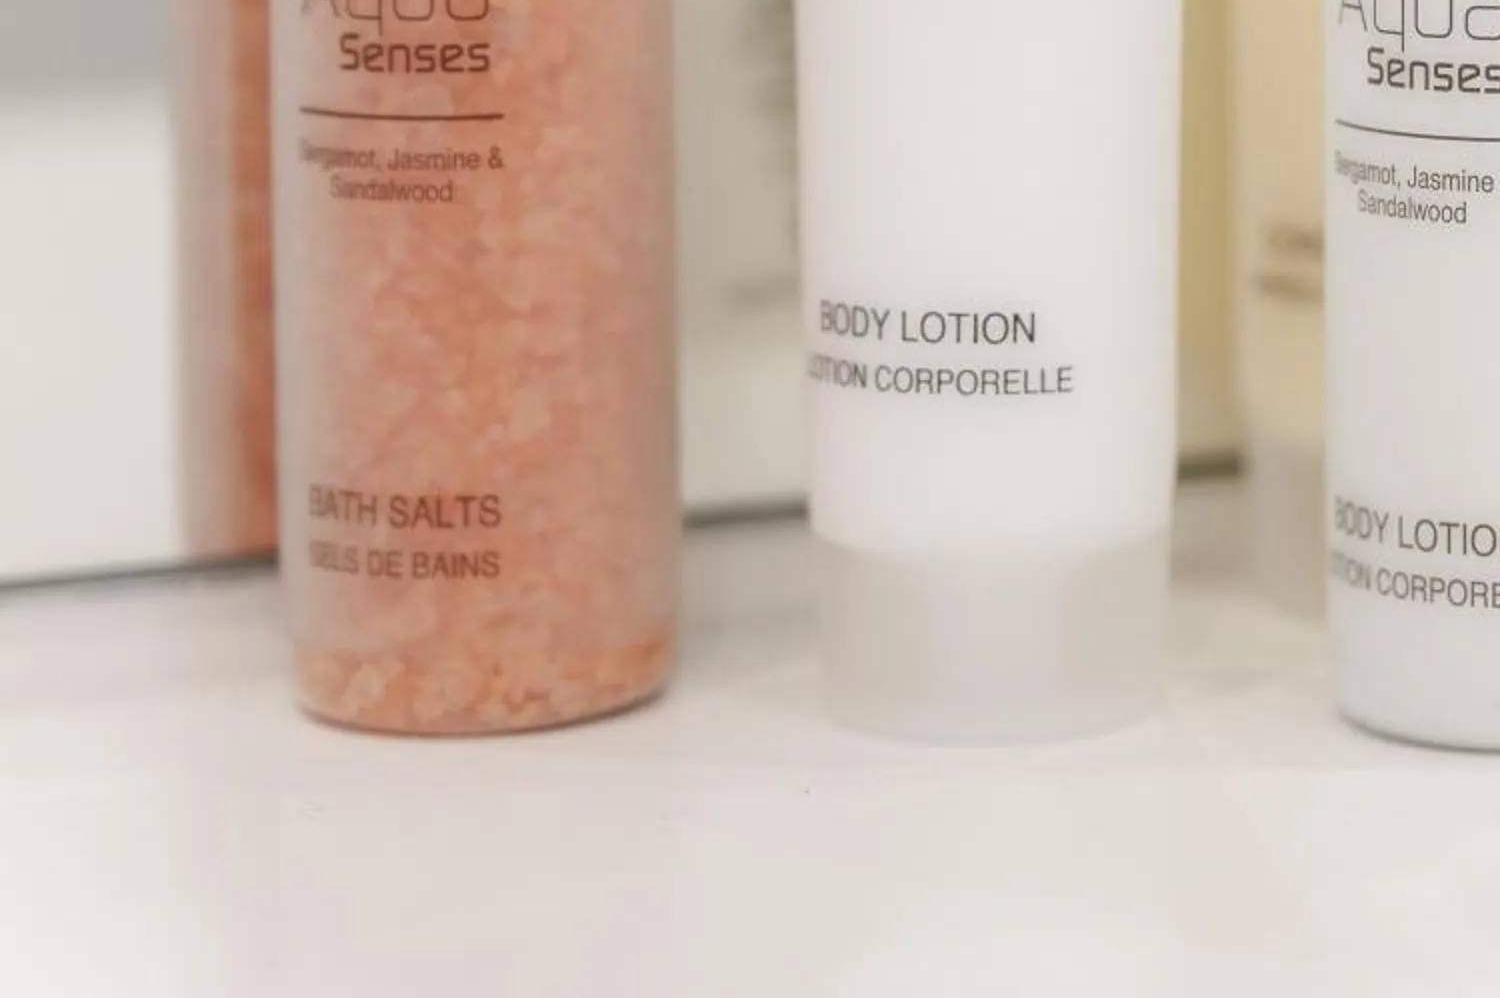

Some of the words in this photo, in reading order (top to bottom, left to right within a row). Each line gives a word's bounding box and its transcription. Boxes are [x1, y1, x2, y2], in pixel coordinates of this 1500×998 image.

[340, 32, 491, 73] Senses
[388, 149, 481, 171] Jasmine
[488, 146, 504, 170] &
[1407, 166, 1494, 193] Jasmine
[1357, 189, 1468, 224] Sandalwood
[820, 299, 890, 340] BODY
[900, 310, 1036, 344] LOTION
[874, 363, 1074, 396] CORPORELLE
[308, 483, 377, 527] BATH
[387, 492, 503, 529] SALTS
[367, 548, 404, 579] DE
[412, 547, 502, 580] BAINS
